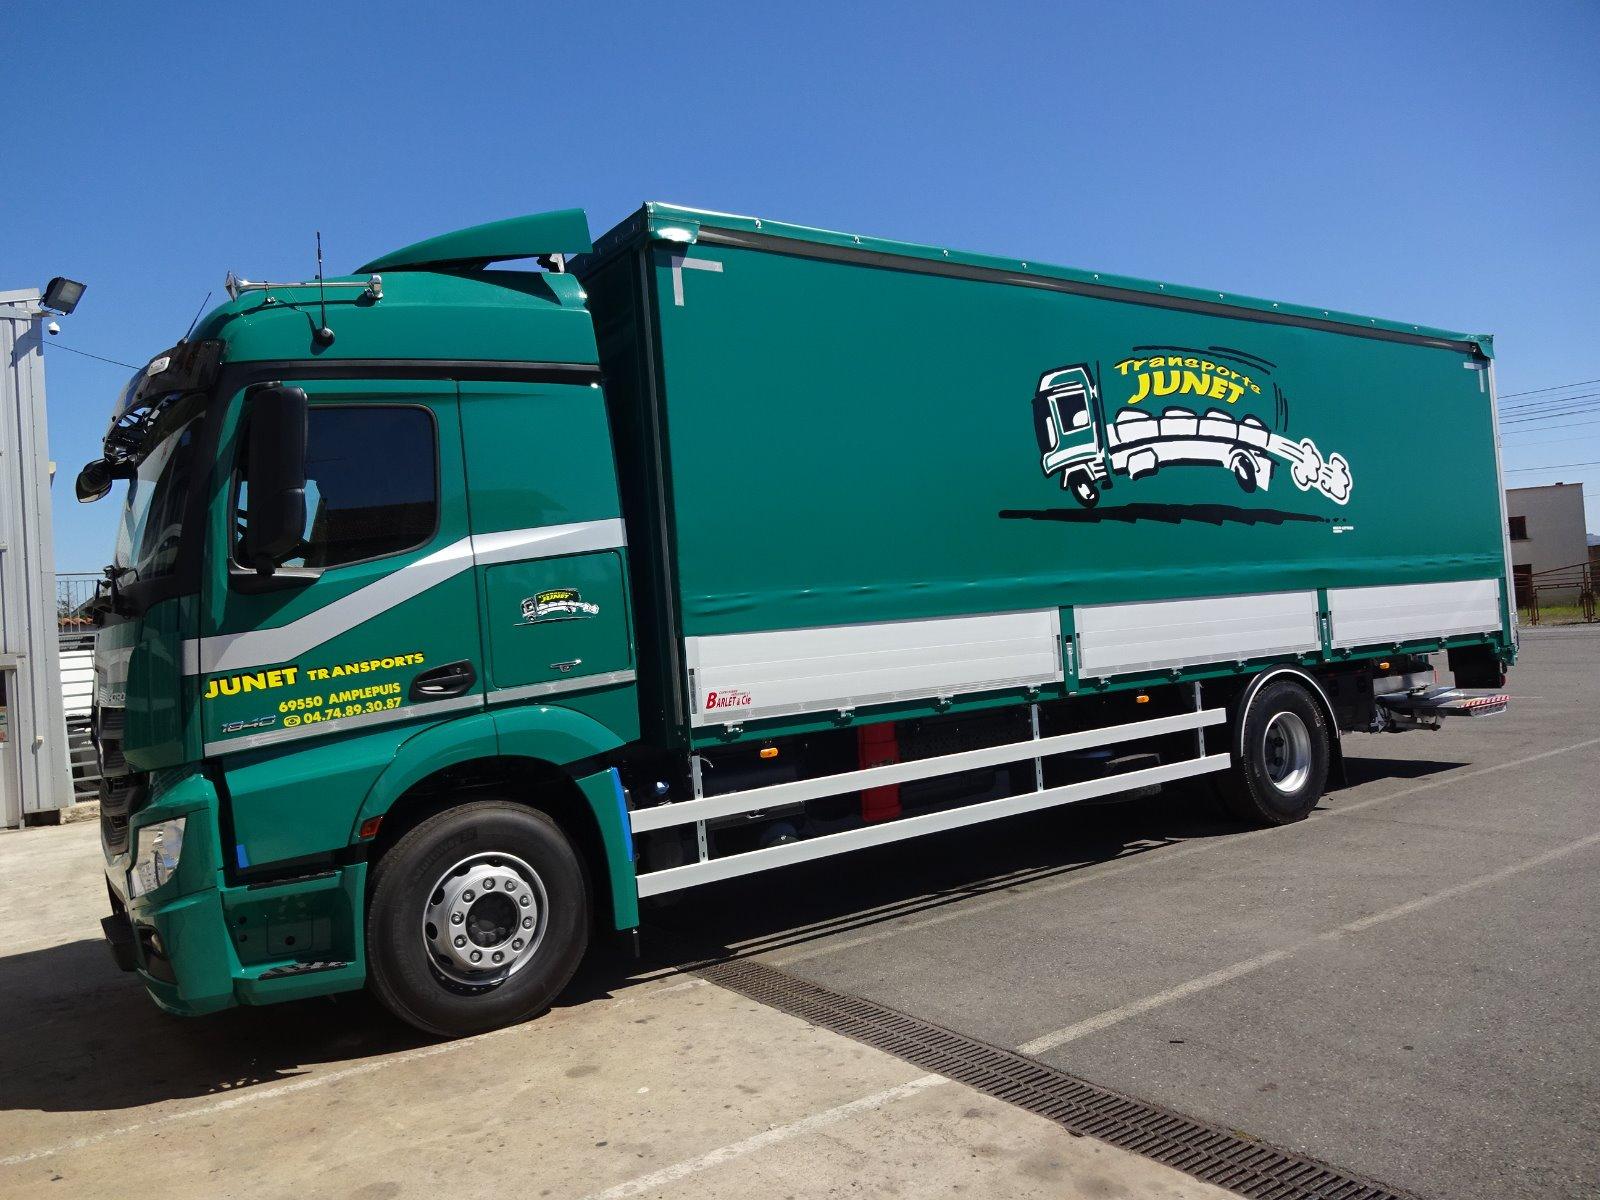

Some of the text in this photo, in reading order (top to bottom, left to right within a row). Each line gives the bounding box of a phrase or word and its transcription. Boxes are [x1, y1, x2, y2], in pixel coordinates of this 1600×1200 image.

[1114, 356, 1261, 395] Transports
[1127, 370, 1245, 404] JUNET
[204, 653, 425, 699] JUNET TRANSPORTS
[278, 683, 401, 712] 69550 AMPLEPUIS
[303, 697, 402, 724] 04.74.89.30.87
[706, 692, 736, 709] BARLET
[741, 695, 752, 705] Cie
[221, 715, 276, 733] 1840
